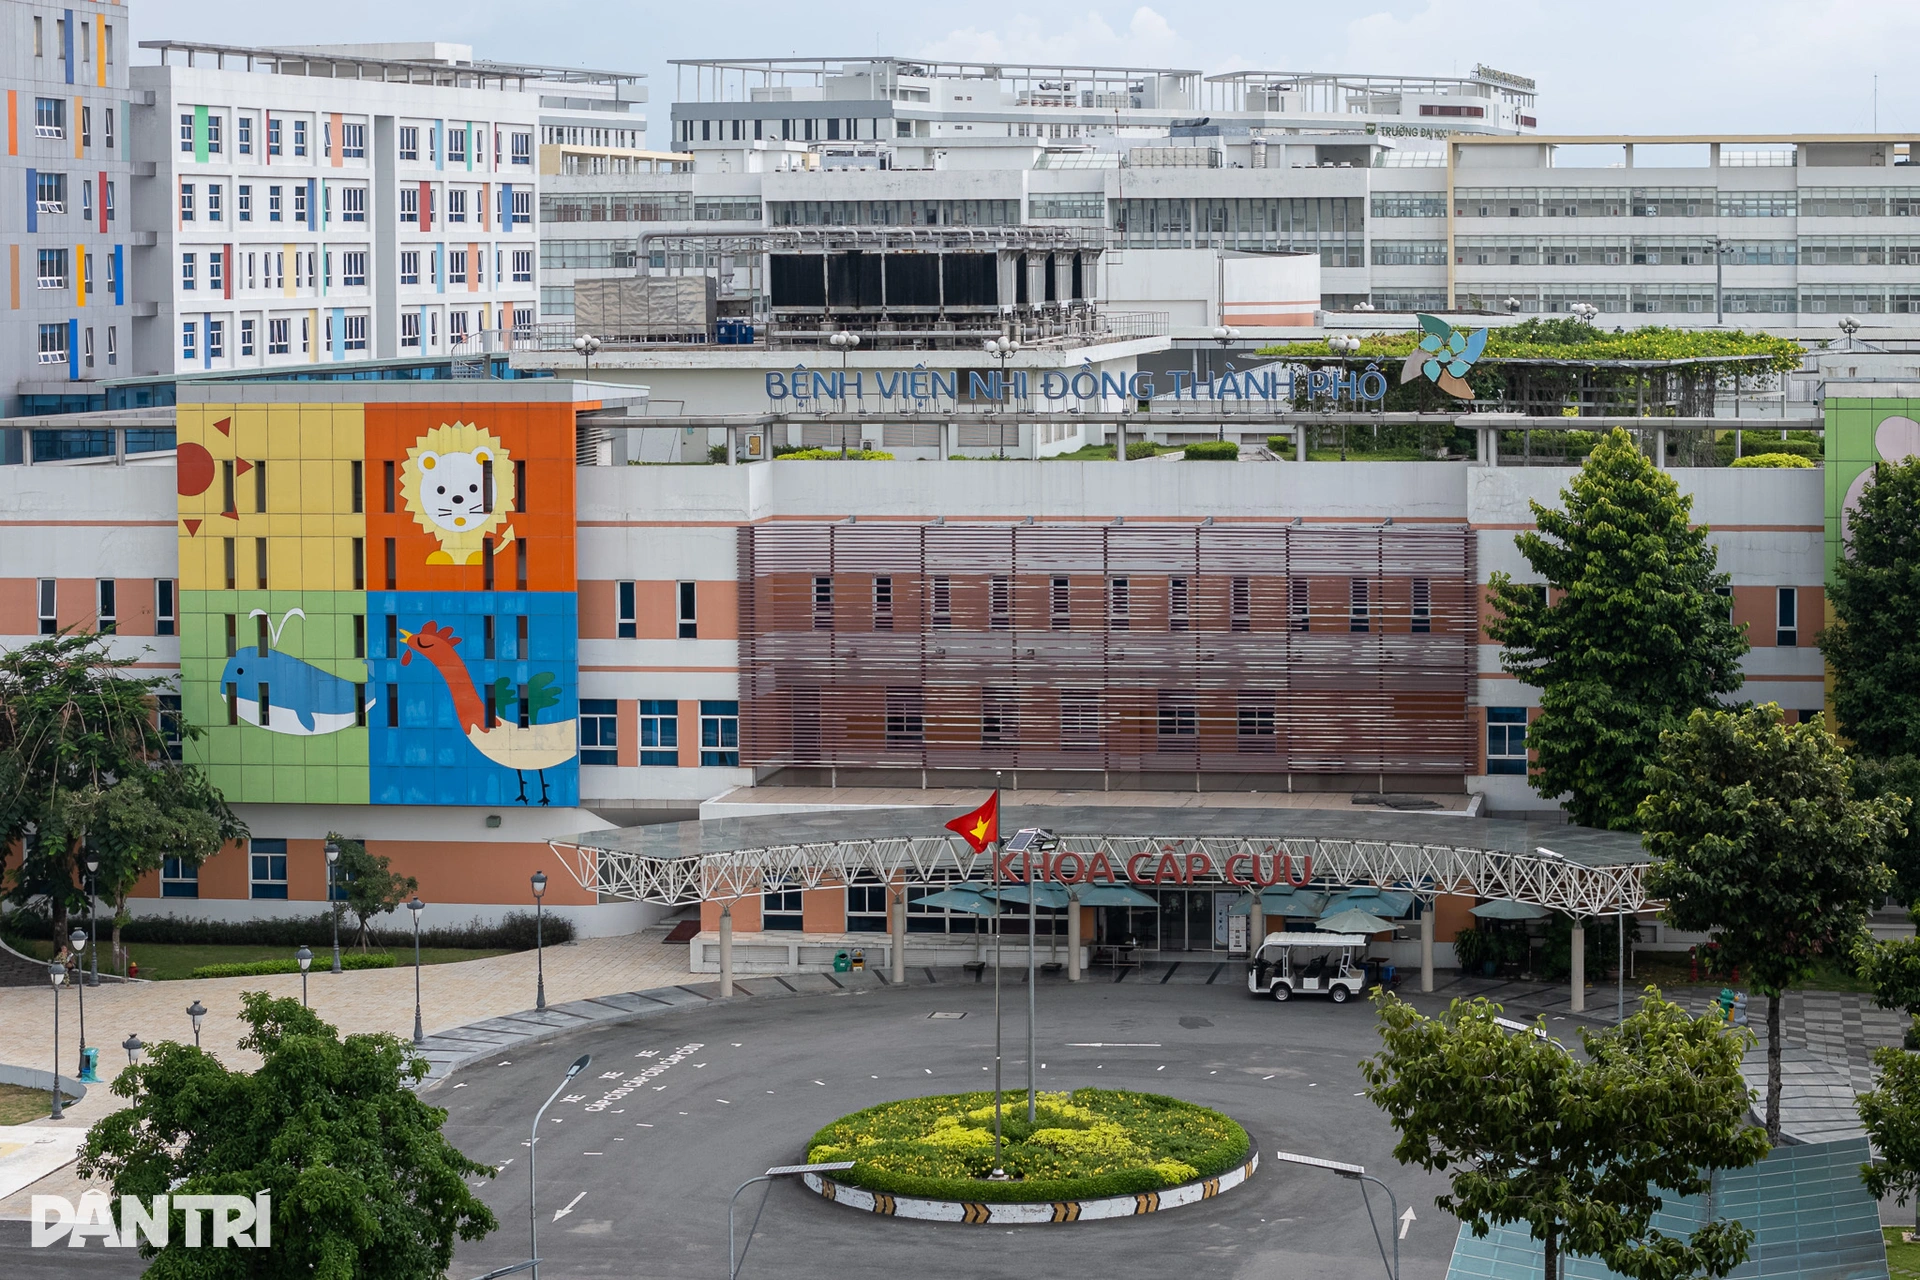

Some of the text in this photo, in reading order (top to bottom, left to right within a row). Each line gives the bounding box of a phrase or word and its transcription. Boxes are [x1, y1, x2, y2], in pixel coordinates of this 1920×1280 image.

[1380, 124, 1418, 137] TRƯỜNG
[1420, 128, 1433, 140] ĐẠI
[765, 355, 1388, 407] BỆNH VIỆN NHI ĐỒNG THÀNH PHỐ
[993, 839, 1312, 887] KHOA CẤP CỨU
[635, 1050, 660, 1058] XE
[560, 1094, 586, 1103] XE
